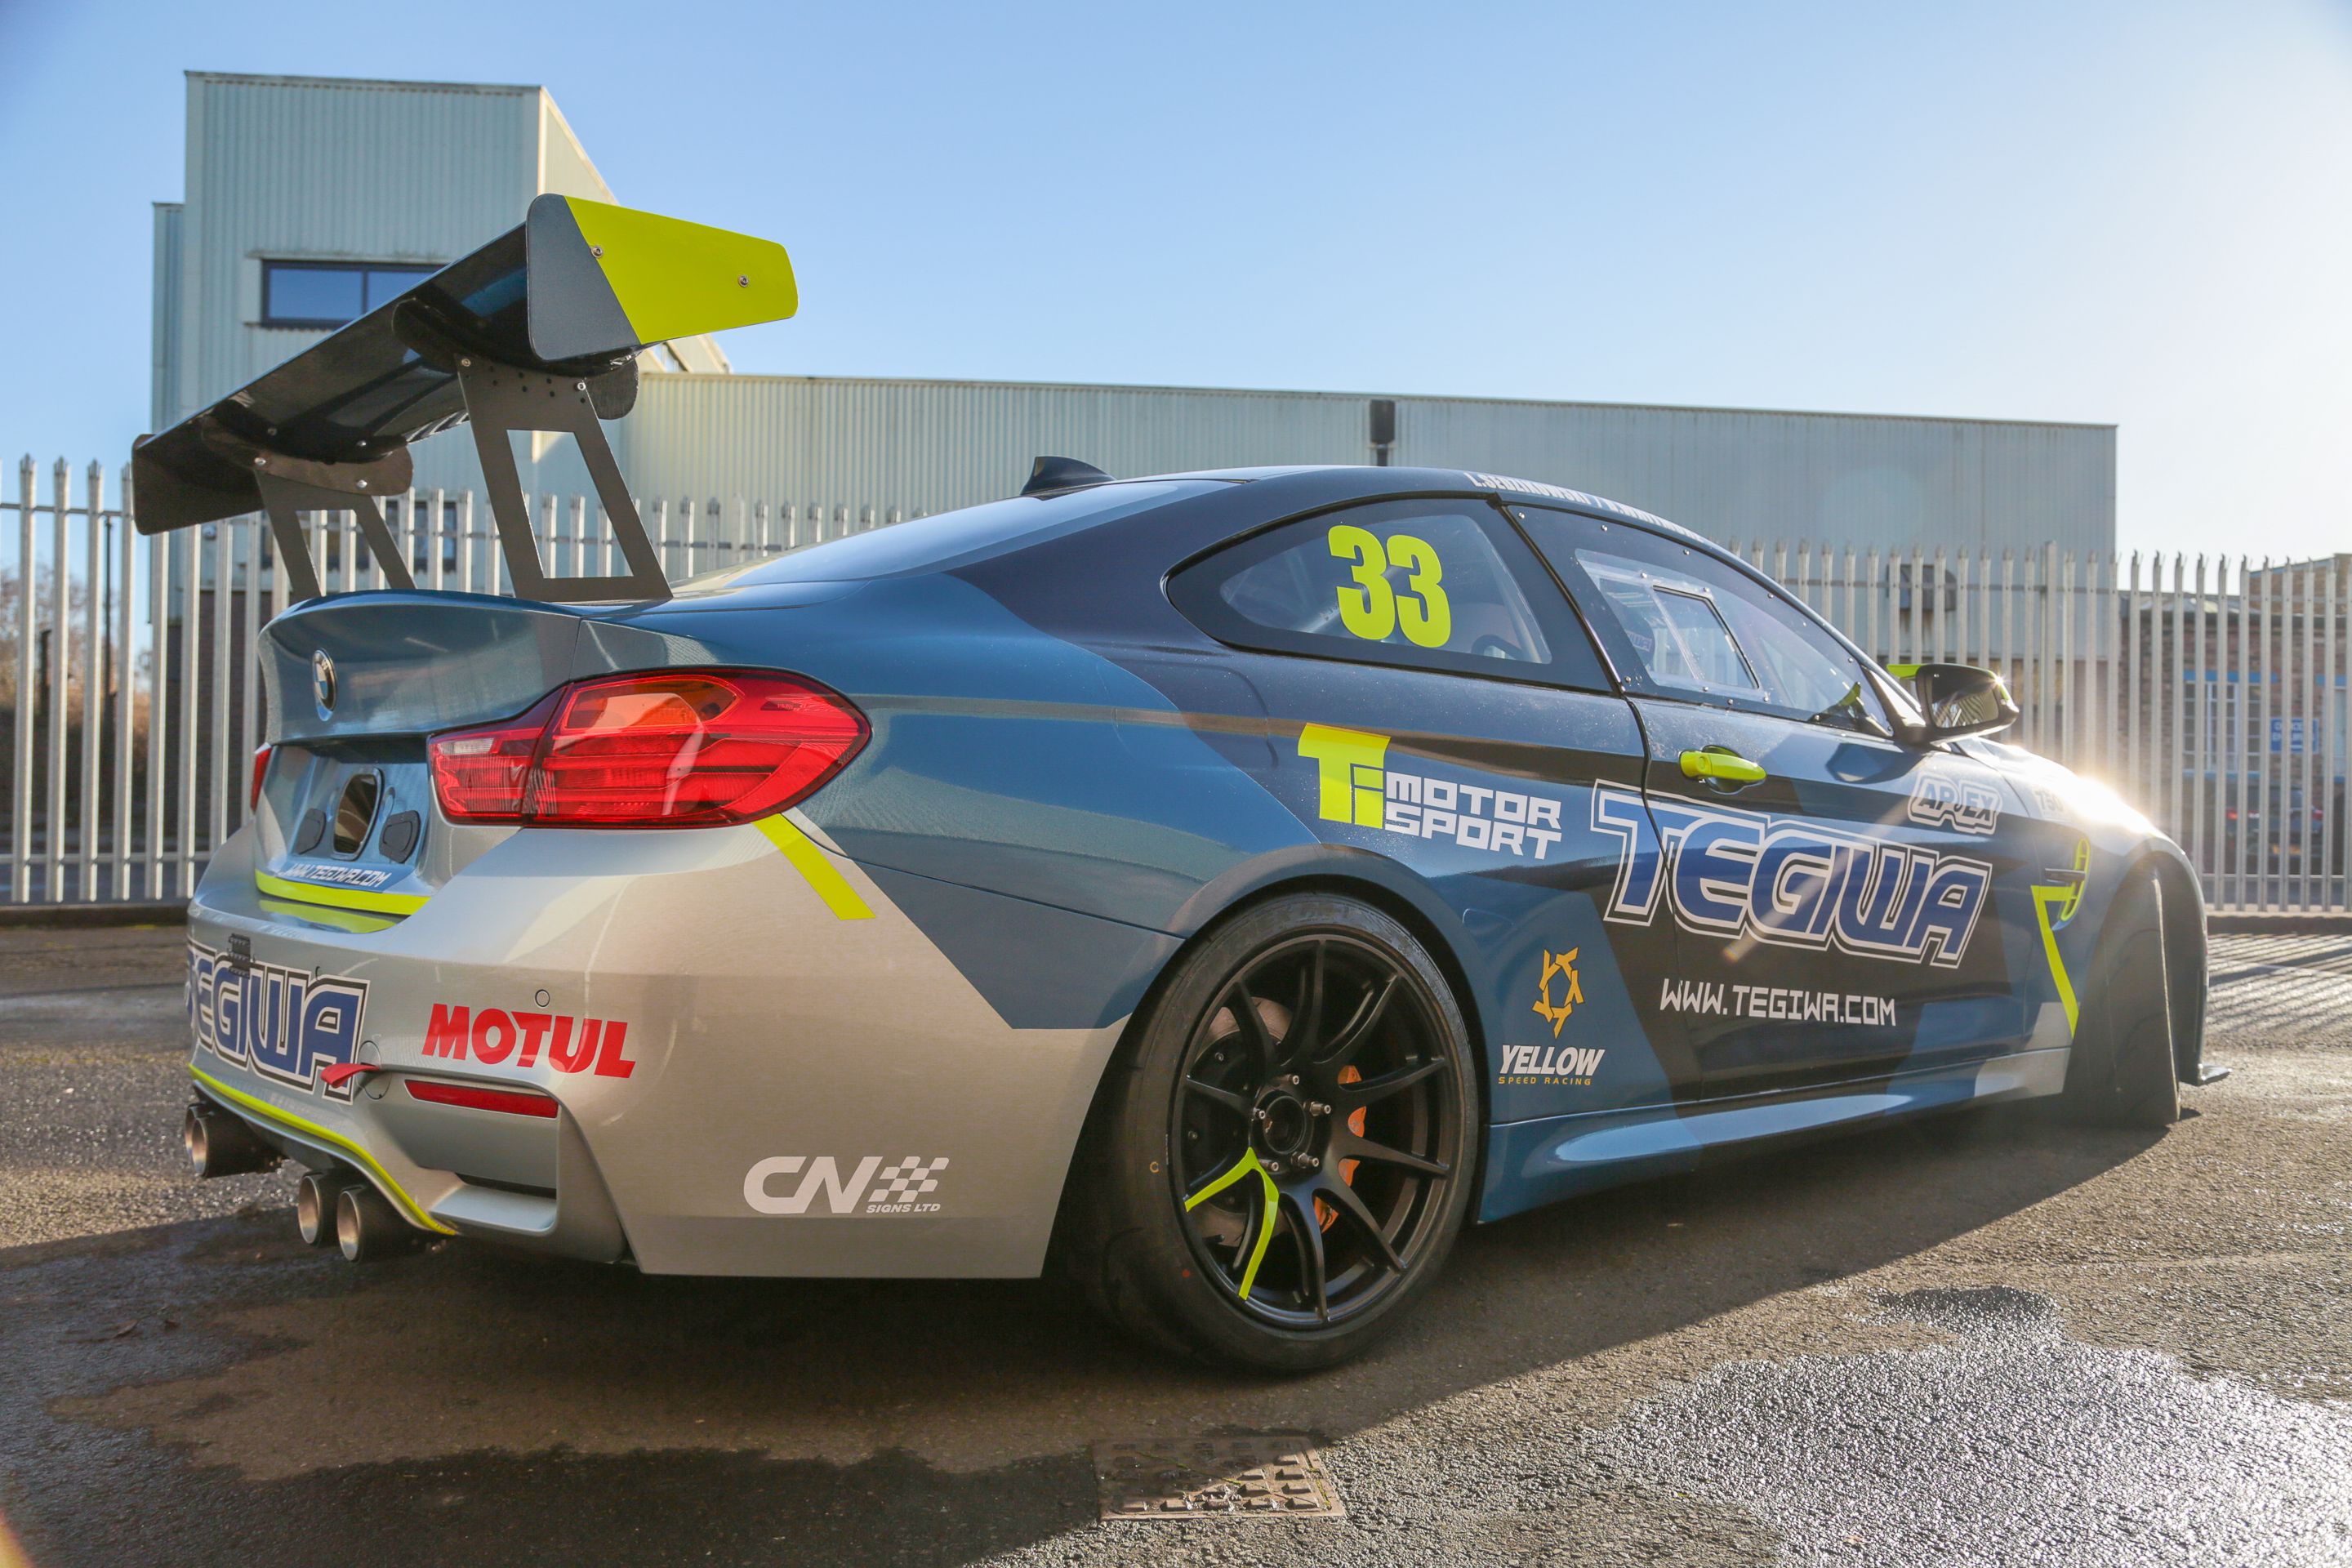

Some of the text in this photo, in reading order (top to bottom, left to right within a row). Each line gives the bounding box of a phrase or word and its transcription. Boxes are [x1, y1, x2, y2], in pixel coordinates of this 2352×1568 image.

[1328, 525, 1451, 648] 33
[1298, 723, 1391, 829] Ti
[1386, 772, 1561, 829] MOTOR
[1385, 801, 1561, 859] SPORT
[1660, 978, 1895, 1027] WWW.TEGIWA.COM
[421, 1004, 635, 1078] MOTUL
[1499, 1045, 1605, 1076] YELLOW
[1498, 1076, 1592, 1085] SPEED RACING
[743, 1156, 884, 1214] CN
[866, 1203, 941, 1214] SIGNS LTD
